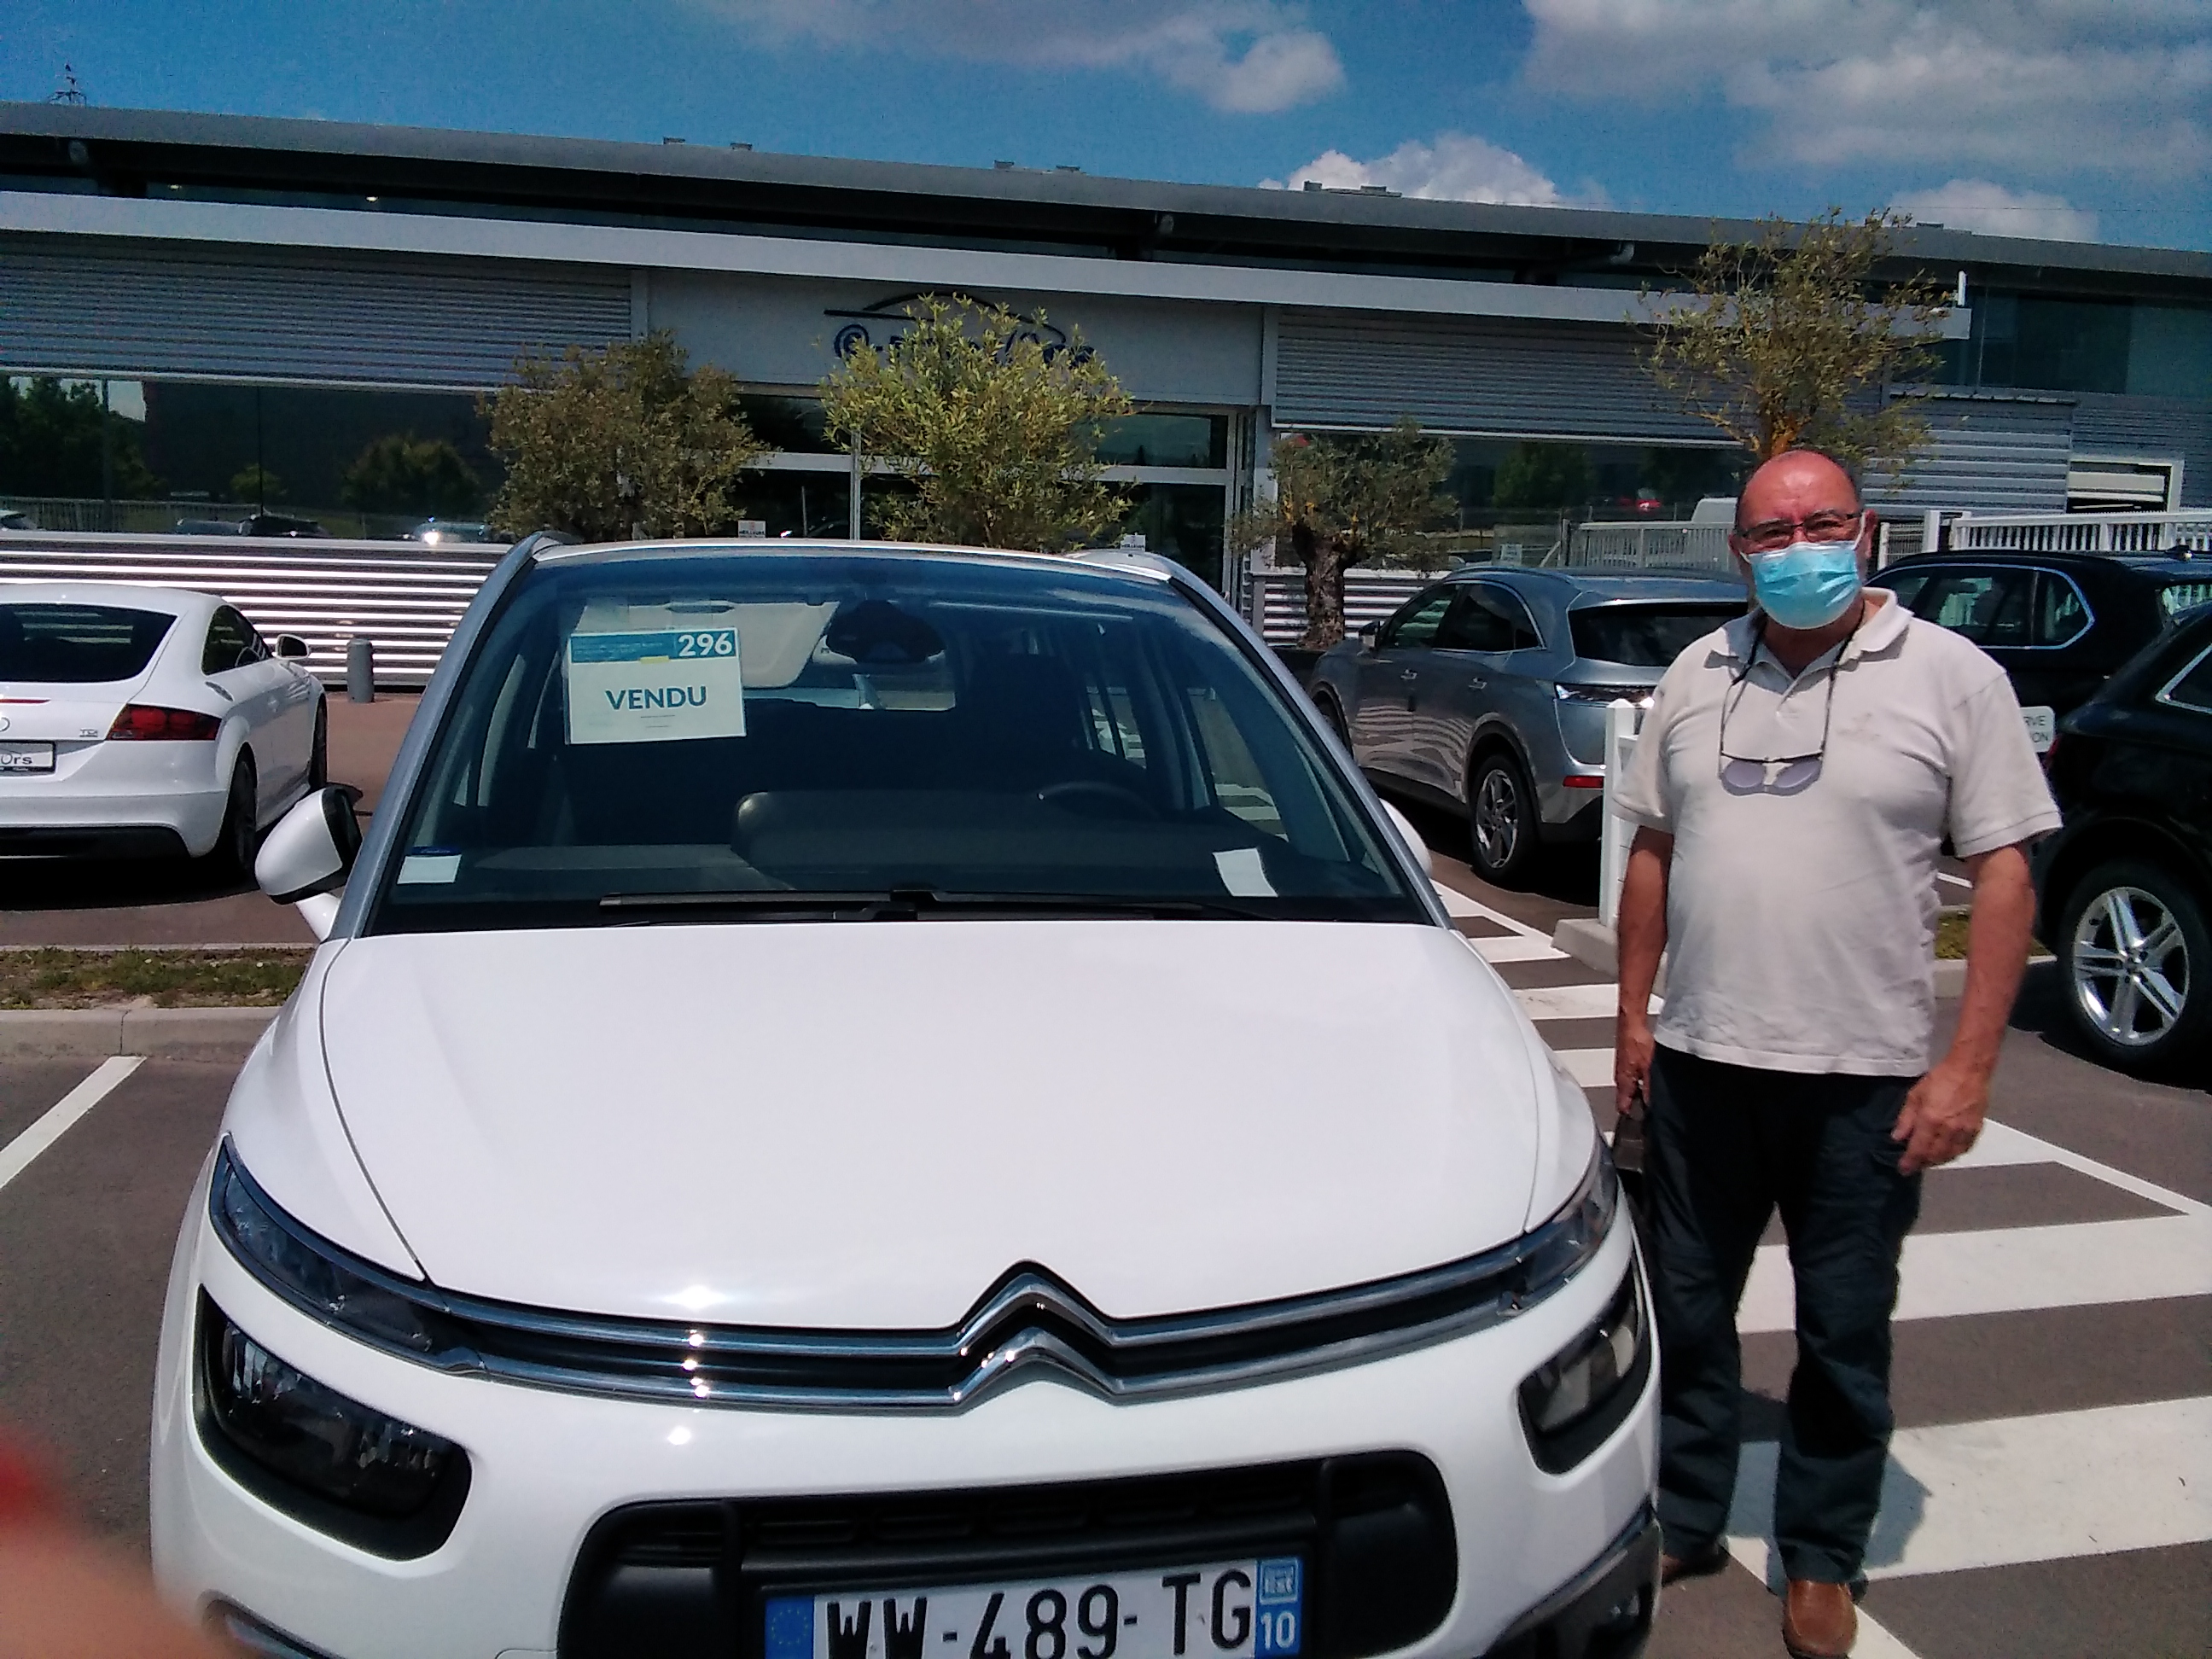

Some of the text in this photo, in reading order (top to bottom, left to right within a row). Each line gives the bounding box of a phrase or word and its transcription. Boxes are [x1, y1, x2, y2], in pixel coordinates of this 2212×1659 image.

[678, 632, 733, 657] 296
[605, 685, 707, 710] VENDU
[1261, 1610, 1295, 1650] 10
